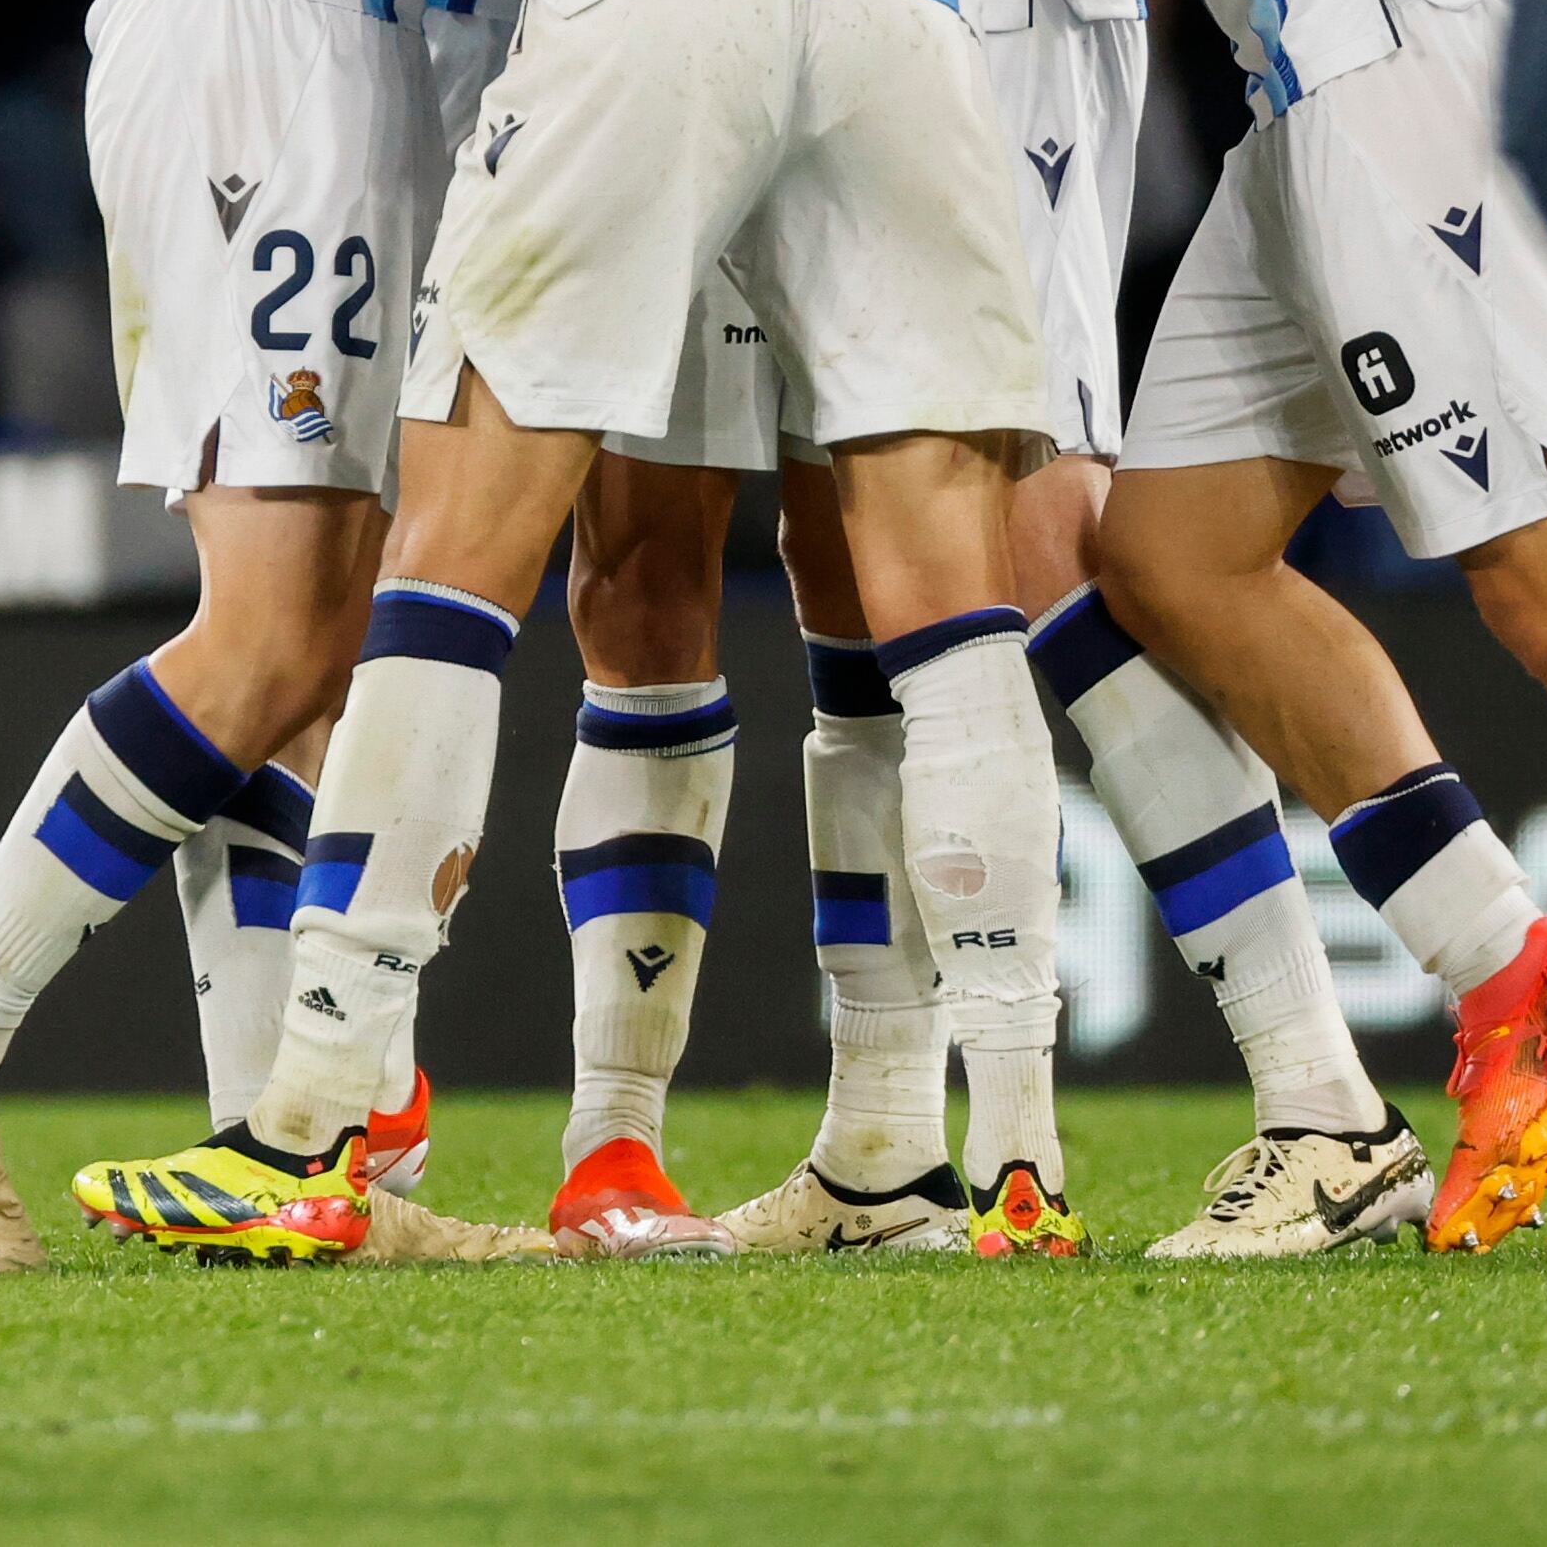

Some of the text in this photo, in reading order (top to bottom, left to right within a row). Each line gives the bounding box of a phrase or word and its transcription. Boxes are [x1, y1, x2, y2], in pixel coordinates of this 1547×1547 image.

[252, 229, 378, 360] 22
[1373, 400, 1478, 458] network
[953, 928, 1018, 950] RS
